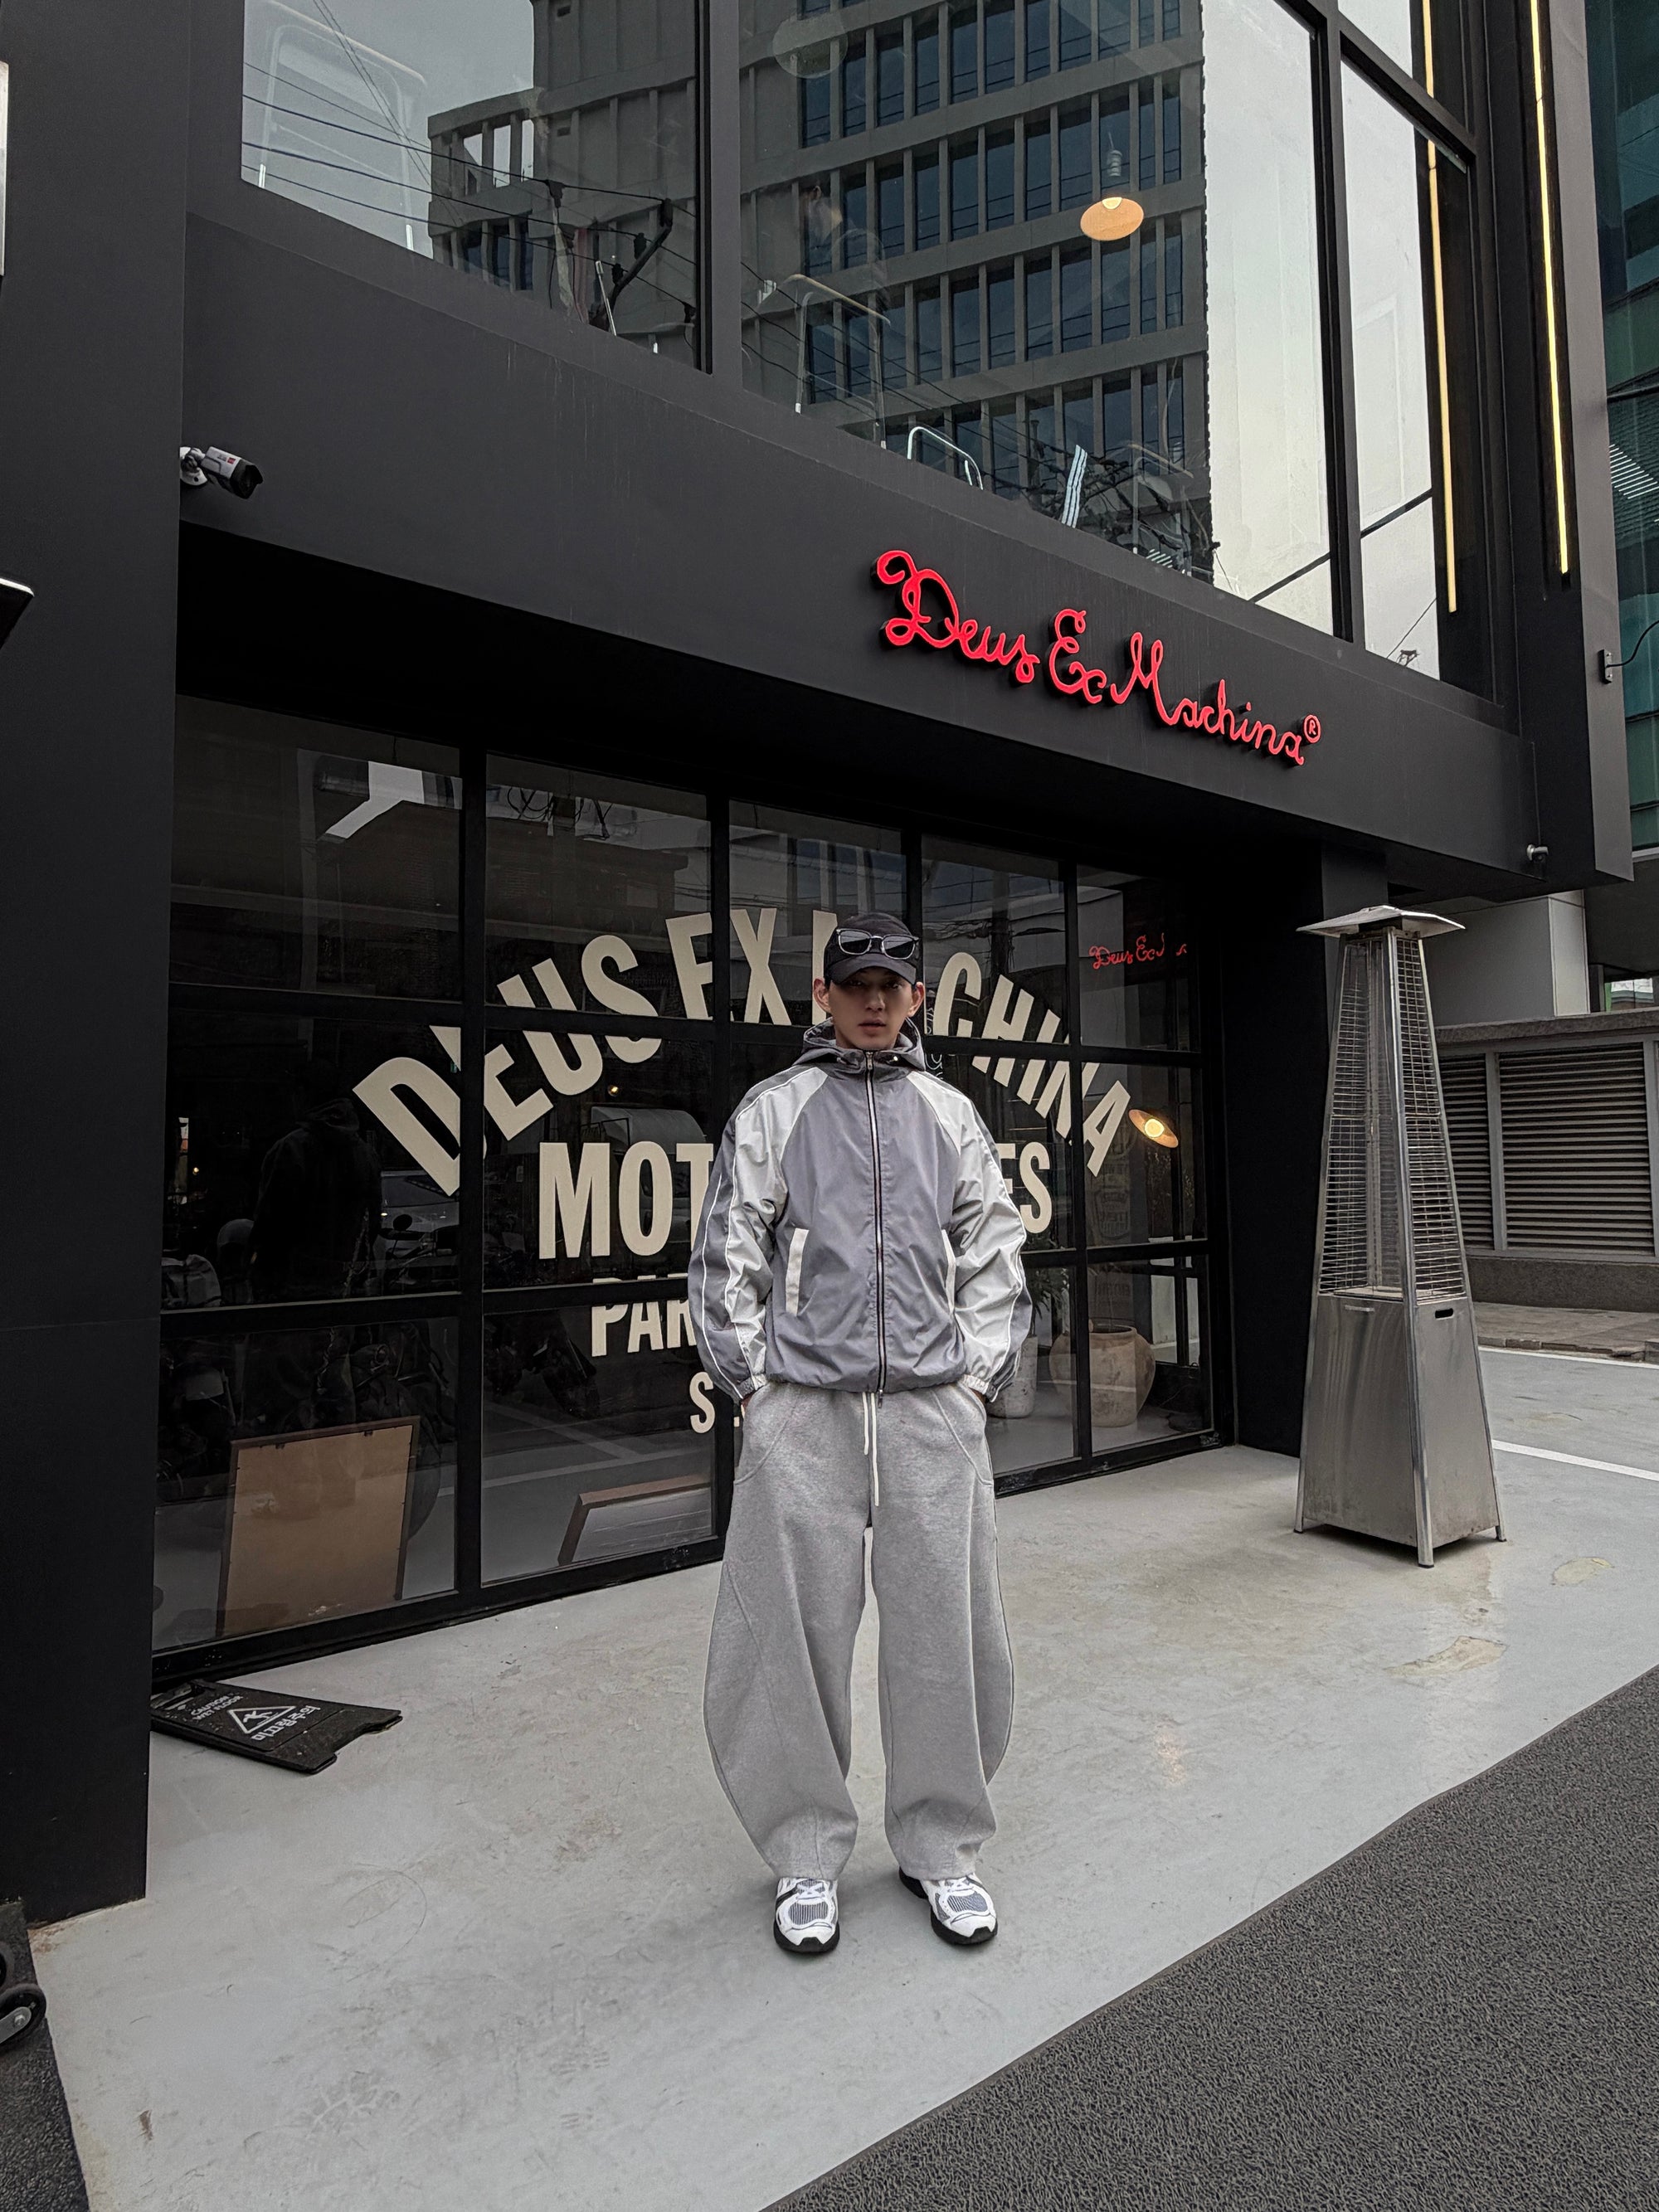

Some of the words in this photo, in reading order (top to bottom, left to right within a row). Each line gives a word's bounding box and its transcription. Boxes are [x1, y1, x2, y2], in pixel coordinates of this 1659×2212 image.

[876, 549, 1040, 683] Deus
[1048, 608, 1107, 704] Ex
[1088, 946, 1134, 970] Deus
[353, 934, 662, 1197] DEUS
[665, 907, 792, 1026] EX
[191, 1695, 230, 1716] CAUTION
